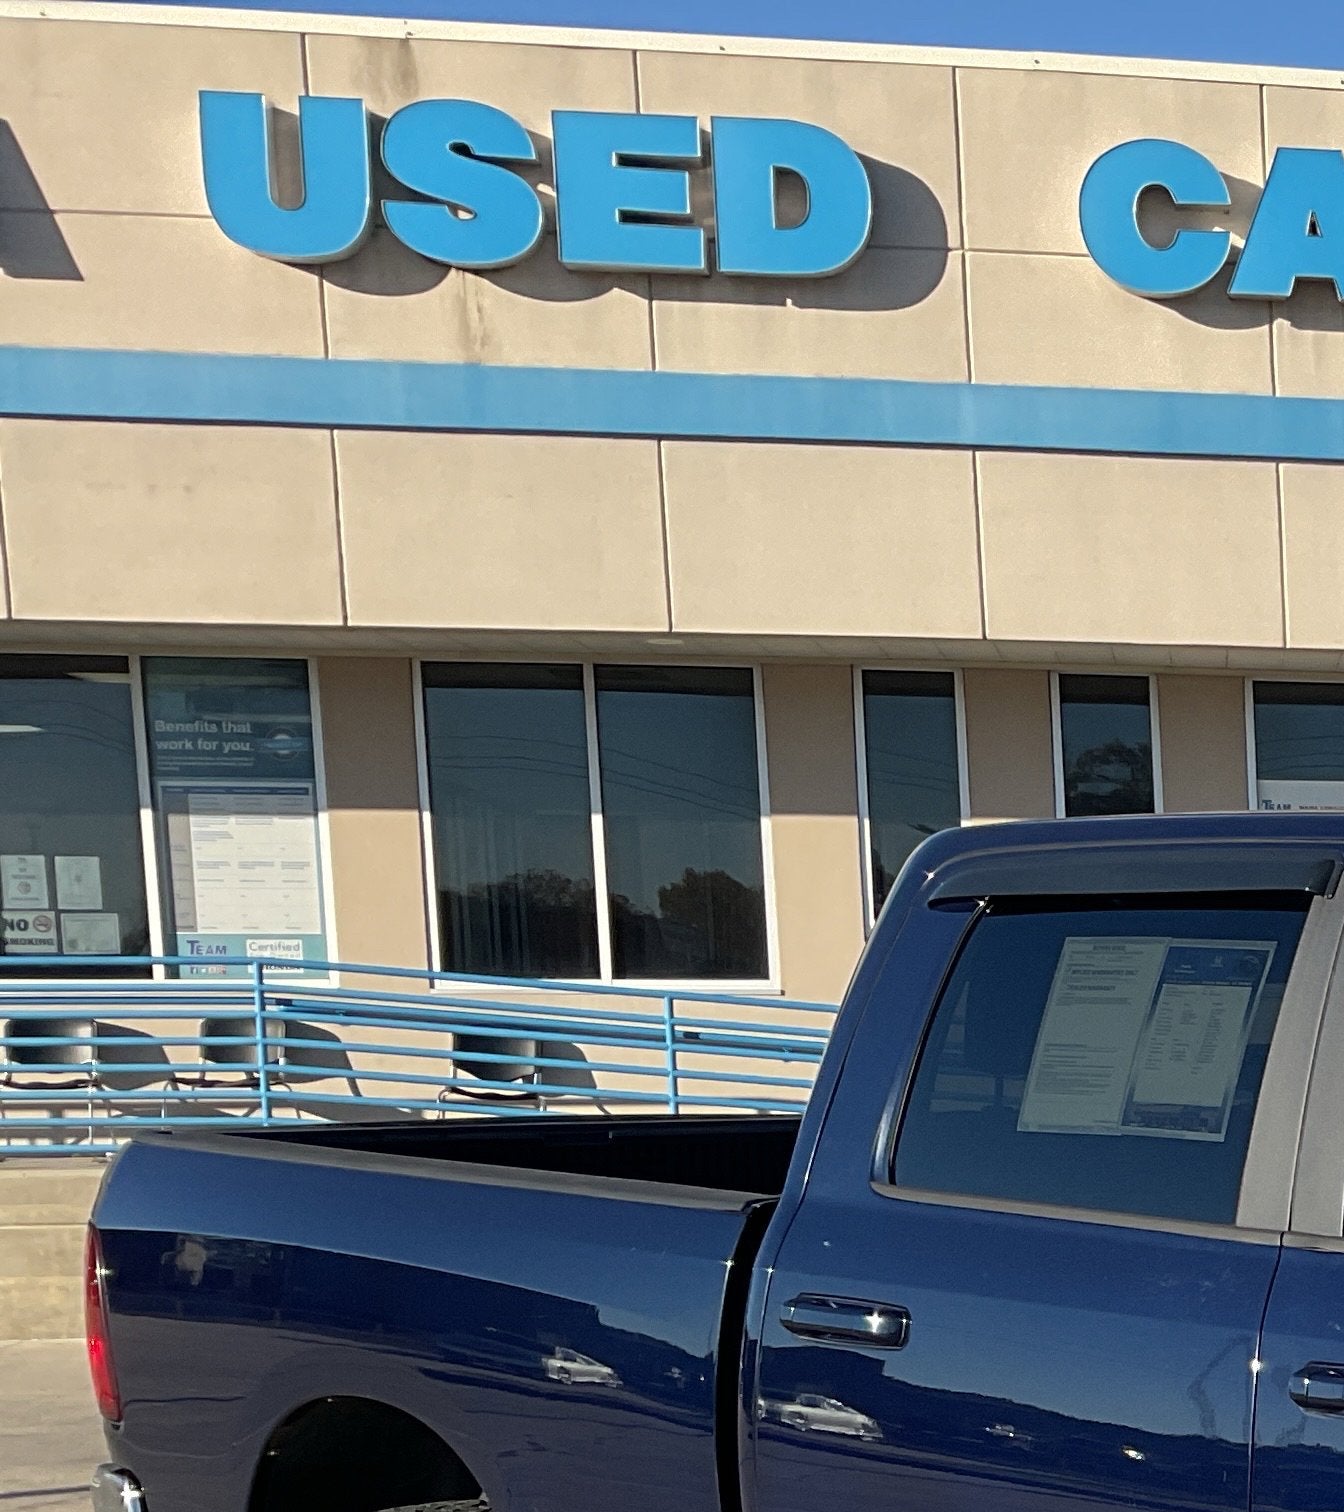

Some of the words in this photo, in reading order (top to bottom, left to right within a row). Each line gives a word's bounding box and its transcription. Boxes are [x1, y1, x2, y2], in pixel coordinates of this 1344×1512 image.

[198, 91, 874, 279] USED
[154, 719, 218, 733] Benefits
[222, 719, 252, 734] that
[155, 739, 194, 750] work
[198, 738, 219, 750] for
[249, 941, 300, 952] Certified
